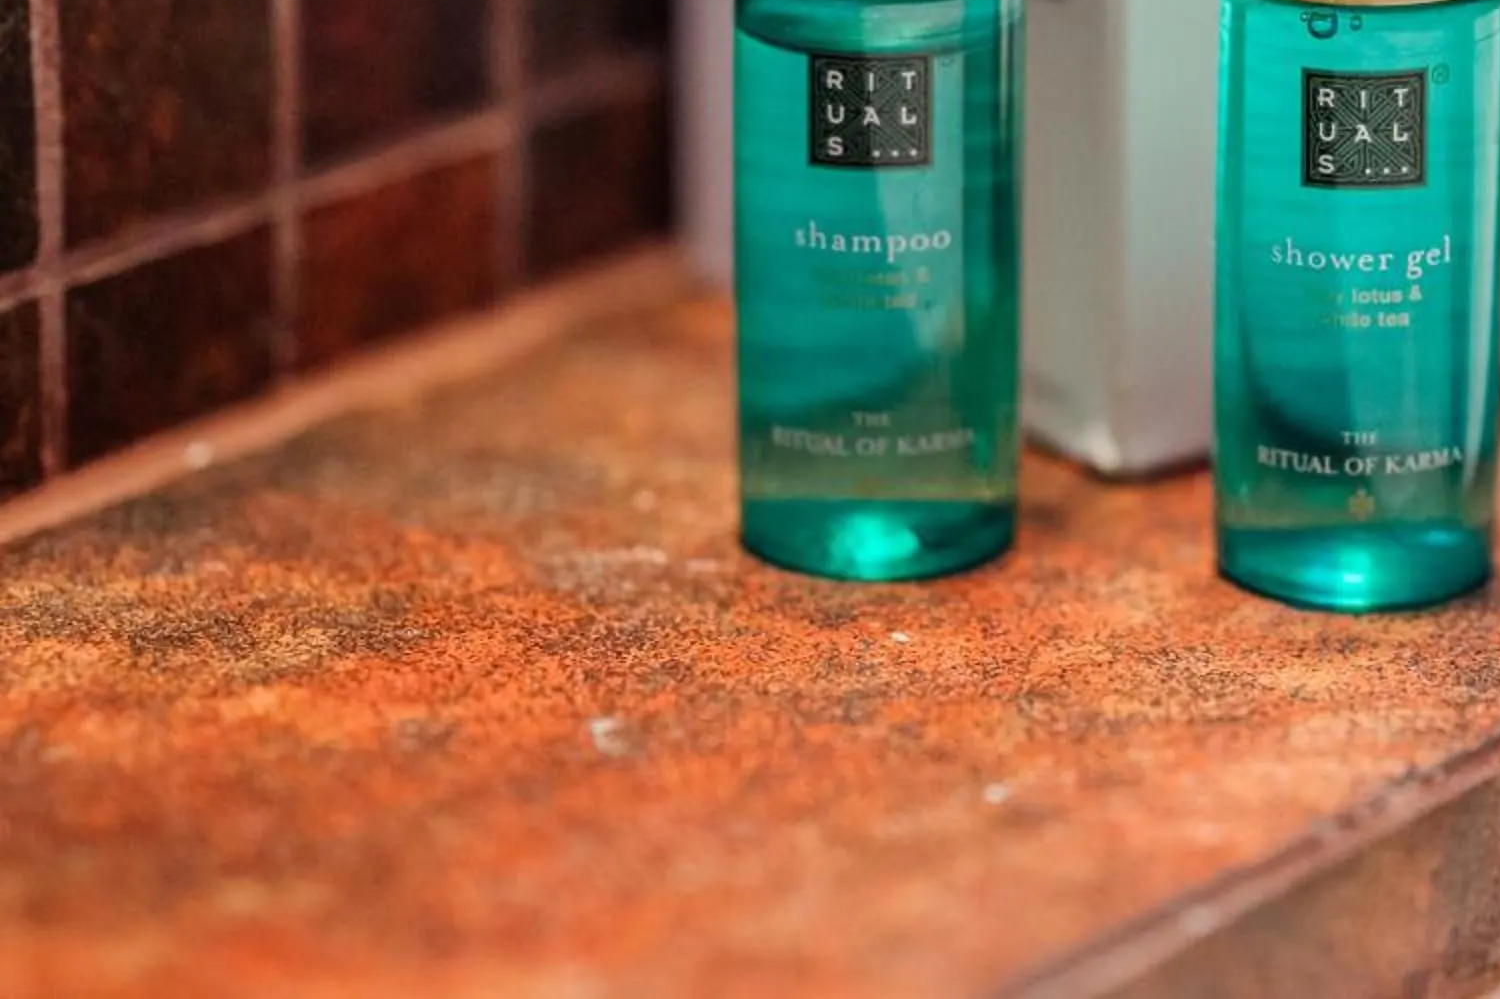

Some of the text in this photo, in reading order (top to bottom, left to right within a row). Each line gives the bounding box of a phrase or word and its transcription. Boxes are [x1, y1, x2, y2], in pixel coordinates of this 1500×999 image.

[795, 218, 951, 263] shampoo
[1270, 234, 1451, 279] shower gel
[1341, 430, 1378, 446] THE
[1257, 444, 1463, 476] RITUAL OF KARMA
